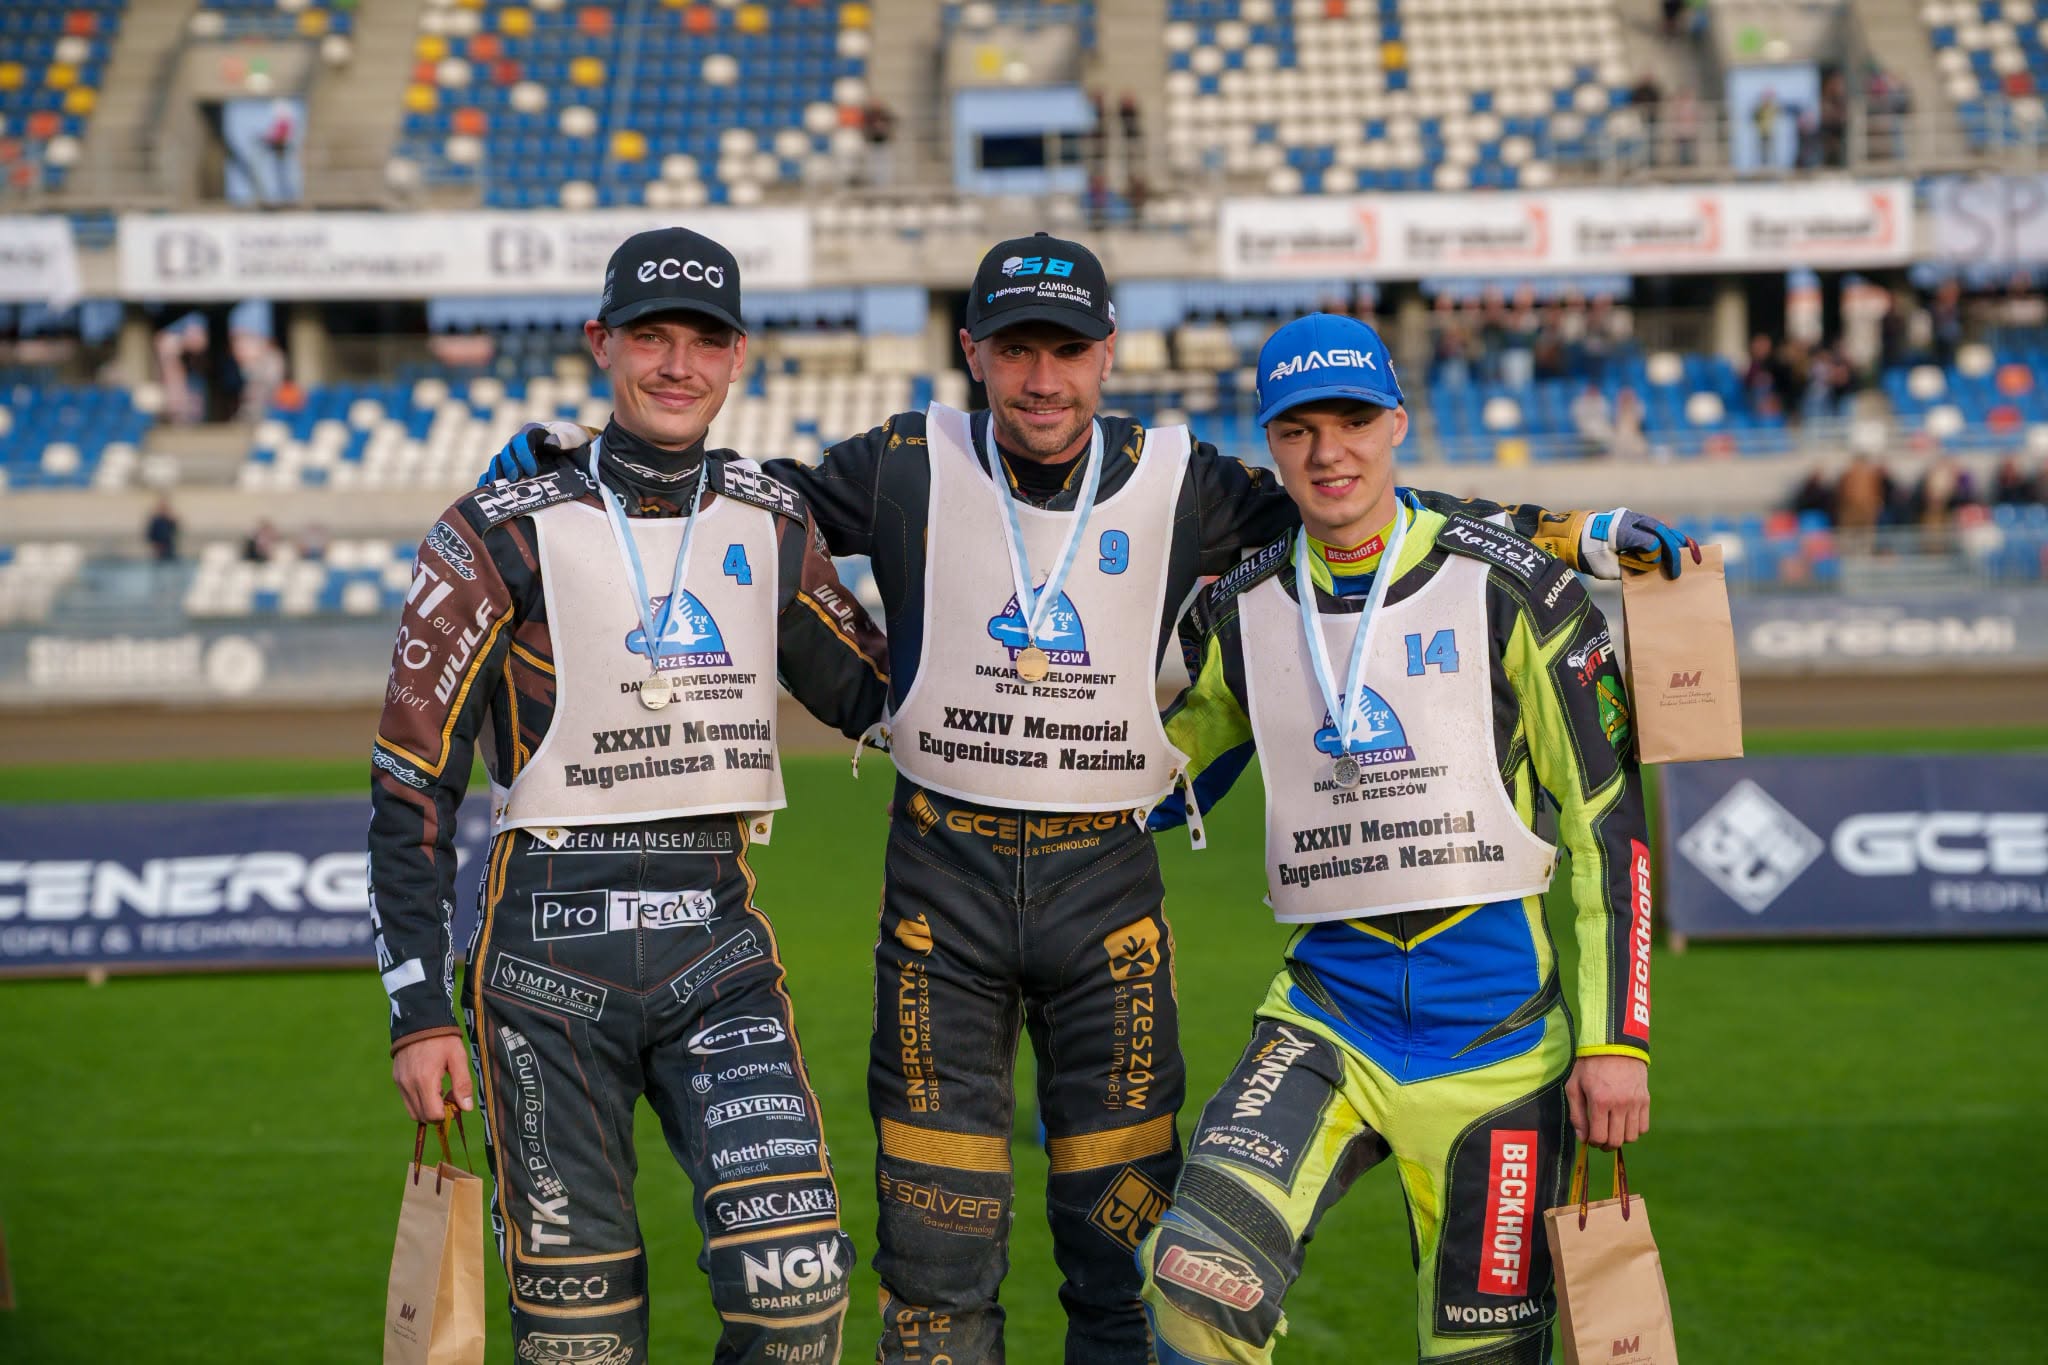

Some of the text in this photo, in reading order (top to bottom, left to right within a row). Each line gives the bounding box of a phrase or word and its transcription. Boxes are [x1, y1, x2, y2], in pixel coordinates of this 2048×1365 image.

[637, 258, 724, 289] ecco
[1284, 349, 1377, 377] MAGIK
[1099, 529, 1130, 575] 9
[1327, 539, 1380, 562] BECKHOFF
[1453, 516, 1485, 532] FIRMA
[1485, 527, 1546, 565] BUDOWLANA
[722, 543, 753, 586] 4
[1058, 612, 1073, 622] ZK
[434, 597, 493, 706] WULF
[1404, 629, 1460, 677] 14
[671, 672, 757, 690] DEVELOPMENT
[995, 682, 1097, 700] STAL RZESZÓW
[944, 706, 1014, 736] XXXIV
[1372, 710, 1389, 721] ZK
[592, 724, 672, 755] XXXIV
[919, 731, 1146, 771] Eugeniusza Nazimka
[564, 752, 717, 789] Eugeniusza
[1359, 765, 1449, 785] EVELOPMENT
[1332, 783, 1428, 806] STAL RZESZÓW
[613, 830, 695, 849] HANSEN
[697, 830, 732, 848] BILER
[1041, 836, 1101, 856] TECHNOLOGY
[1292, 823, 1352, 854] XXXIV
[1278, 840, 1505, 889] Eugeniusza Nazimka
[542, 901, 597, 930] Pro
[1633, 854, 1651, 1028] BECKHOFF
[517, 968, 599, 1006] IMPAKT
[897, 958, 928, 1114] ENERGETYK
[1125, 982, 1156, 1111] rzeszów
[725, 1097, 802, 1119] BYGMA
[711, 1138, 818, 1171] Matthiesen
[1229, 1124, 1290, 1156] BUDOWLANA
[716, 1188, 837, 1226] GARCAREK
[894, 1182, 1002, 1220] solvera
[1490, 1143, 1529, 1287] BECKHOFF
[741, 1234, 845, 1295] NGK
[751, 1283, 842, 1311] SPARK PLUGS
[1444, 1298, 1540, 1325] WODSTAL
